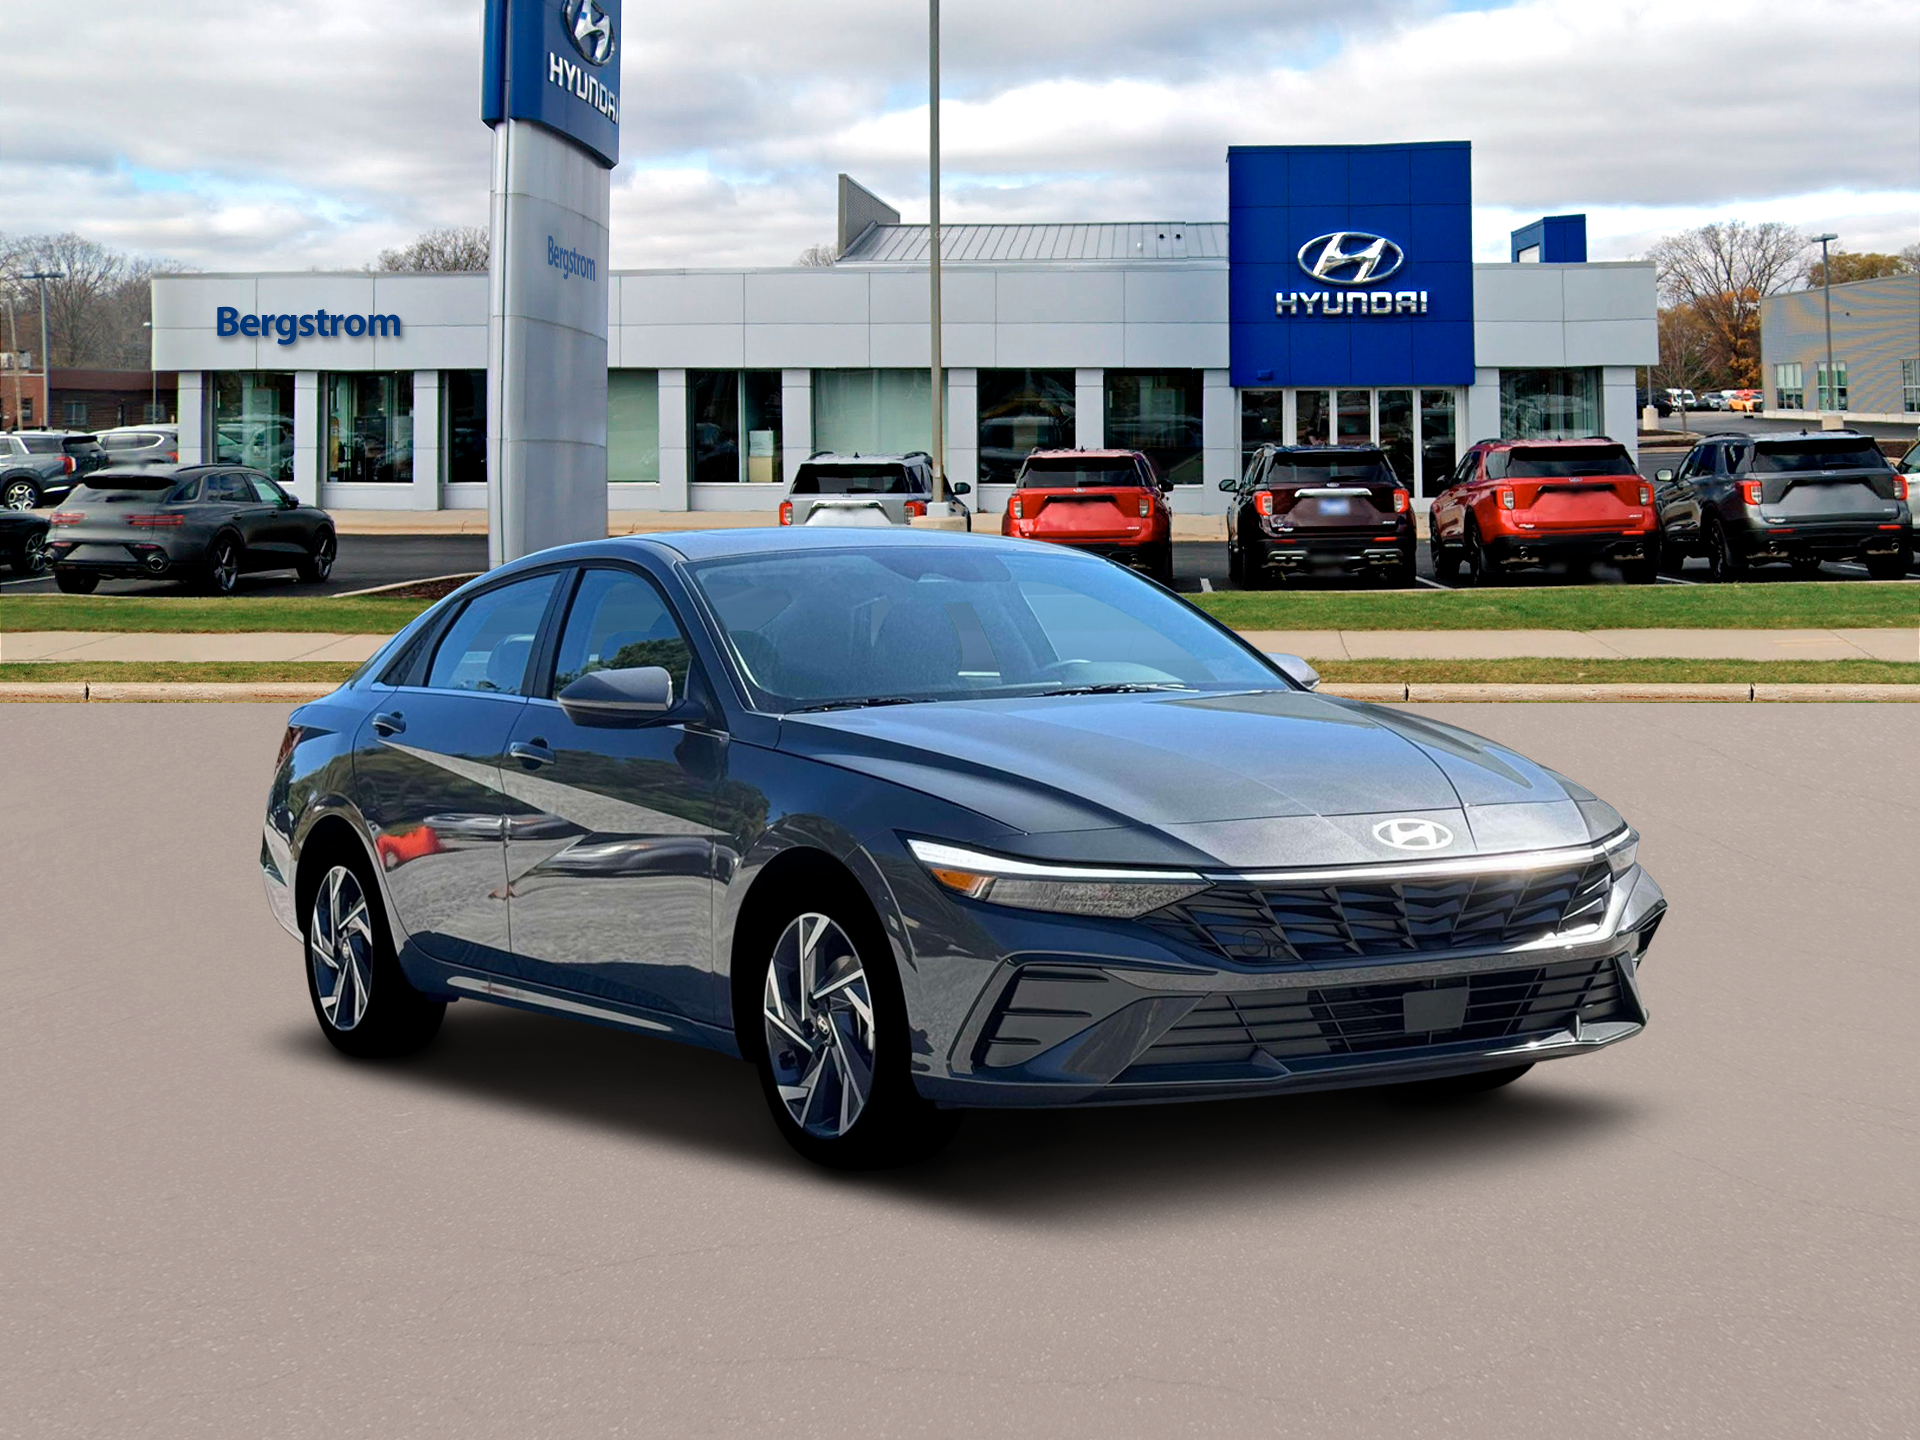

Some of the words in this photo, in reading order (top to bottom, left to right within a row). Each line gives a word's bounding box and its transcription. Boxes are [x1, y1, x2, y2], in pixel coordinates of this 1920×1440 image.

[549, 52, 619, 124] HYUNDAI
[547, 235, 596, 282] Bergstrom
[1275, 291, 1428, 315] HYUNDAI
[216, 306, 402, 346] Bergstrom
